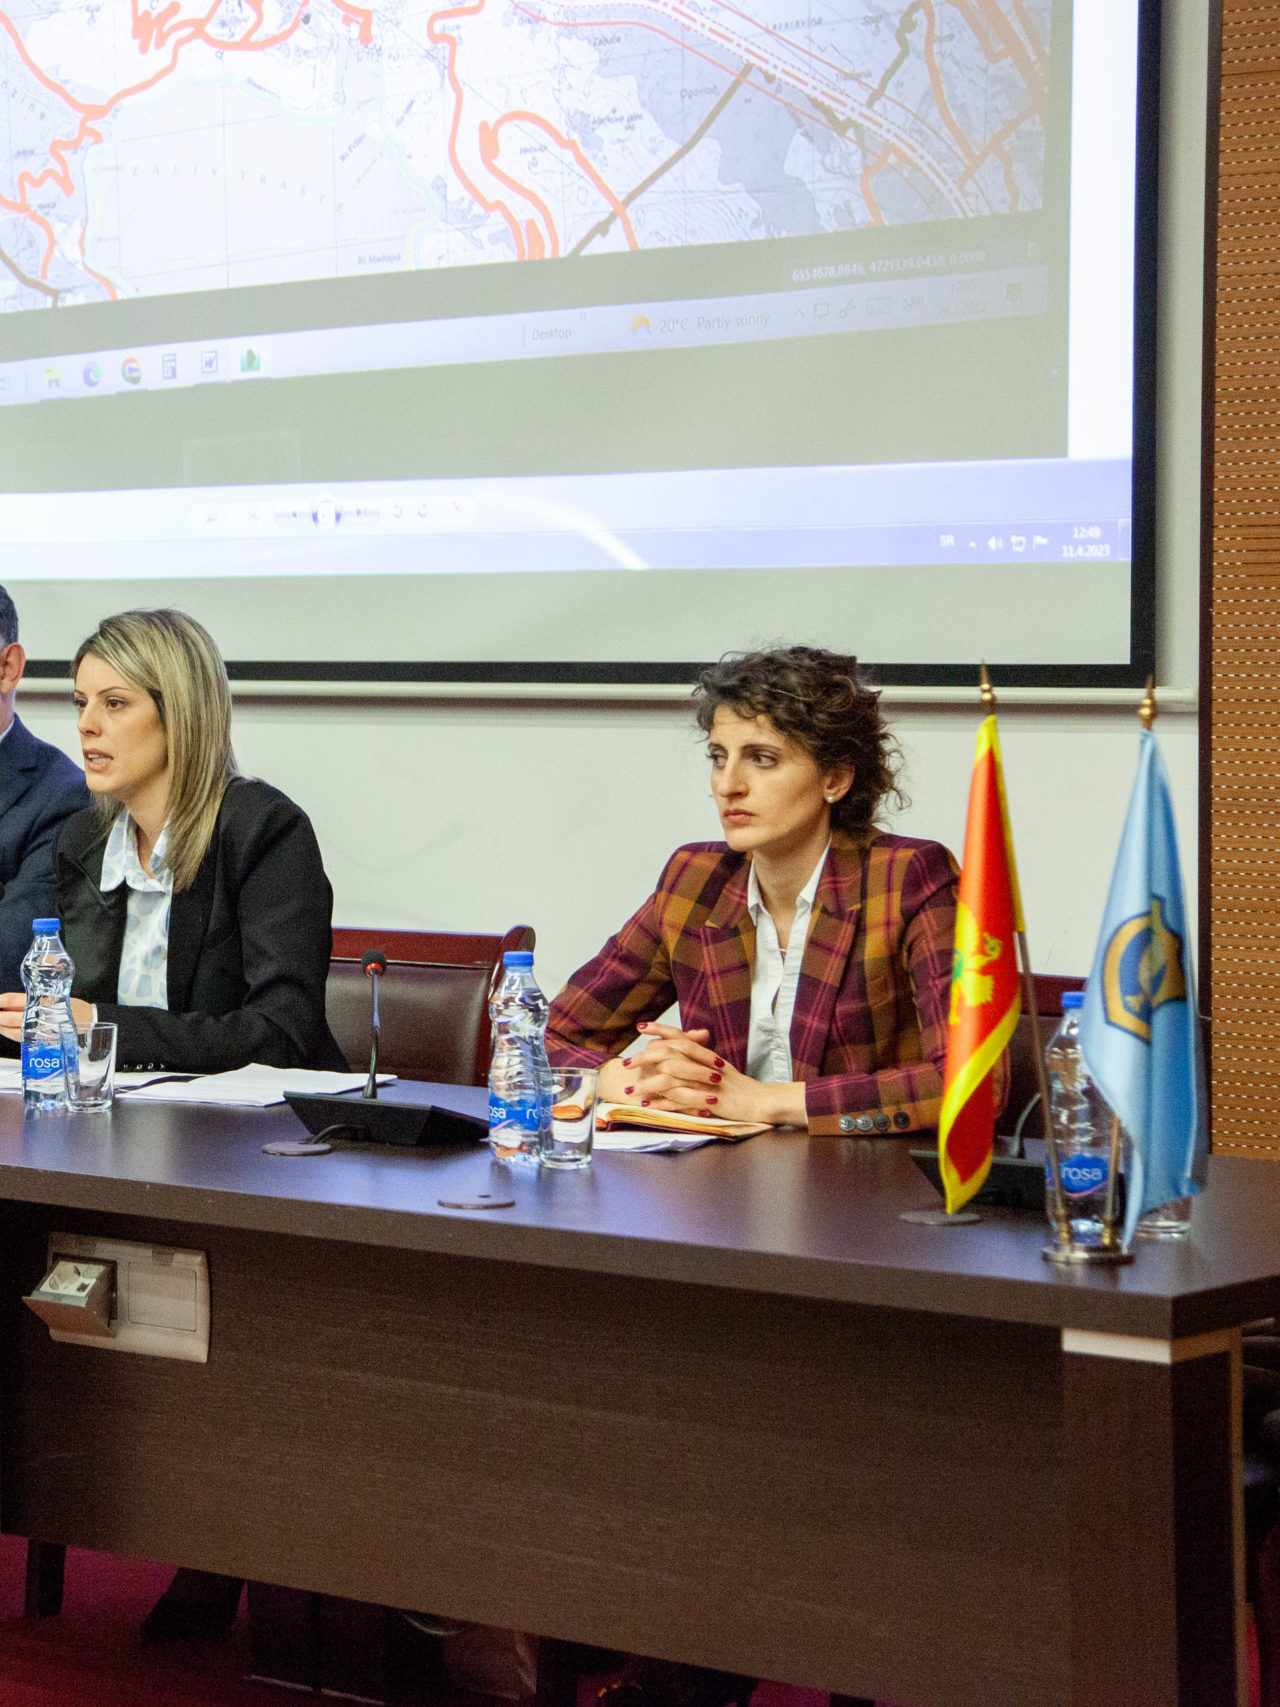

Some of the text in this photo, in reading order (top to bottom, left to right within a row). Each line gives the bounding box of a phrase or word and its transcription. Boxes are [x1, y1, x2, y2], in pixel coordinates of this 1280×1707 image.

[659, 313, 770, 334] 20°C Partly sunny
[531, 328, 572, 342] Desktop
[29, 1057, 60, 1069] rosa
[1061, 1166, 1103, 1181] rosa
